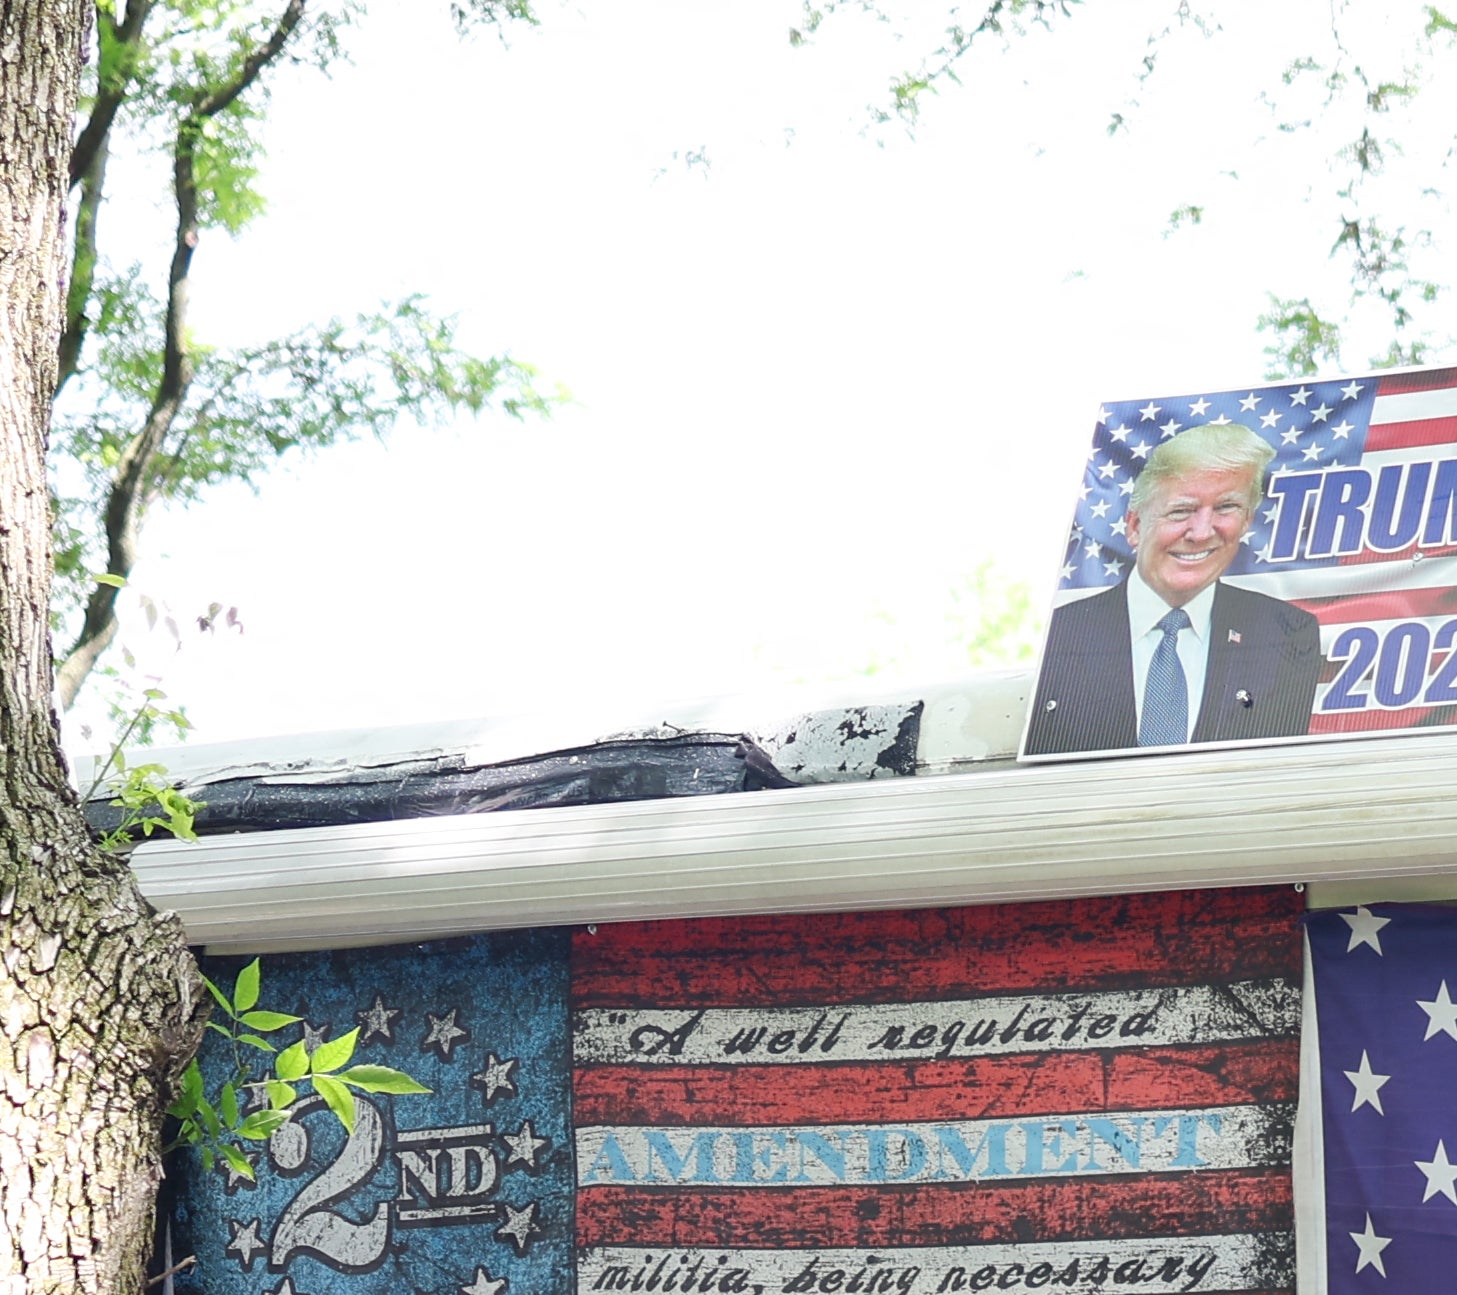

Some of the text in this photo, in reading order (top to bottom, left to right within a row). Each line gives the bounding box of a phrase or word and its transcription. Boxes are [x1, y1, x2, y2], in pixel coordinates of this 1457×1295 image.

[725, 1013, 847, 1056] well
[870, 1000, 1156, 1056] regulated
[584, 1112, 1222, 1184] AMENDMENT
[593, 1255, 761, 1295] militia,
